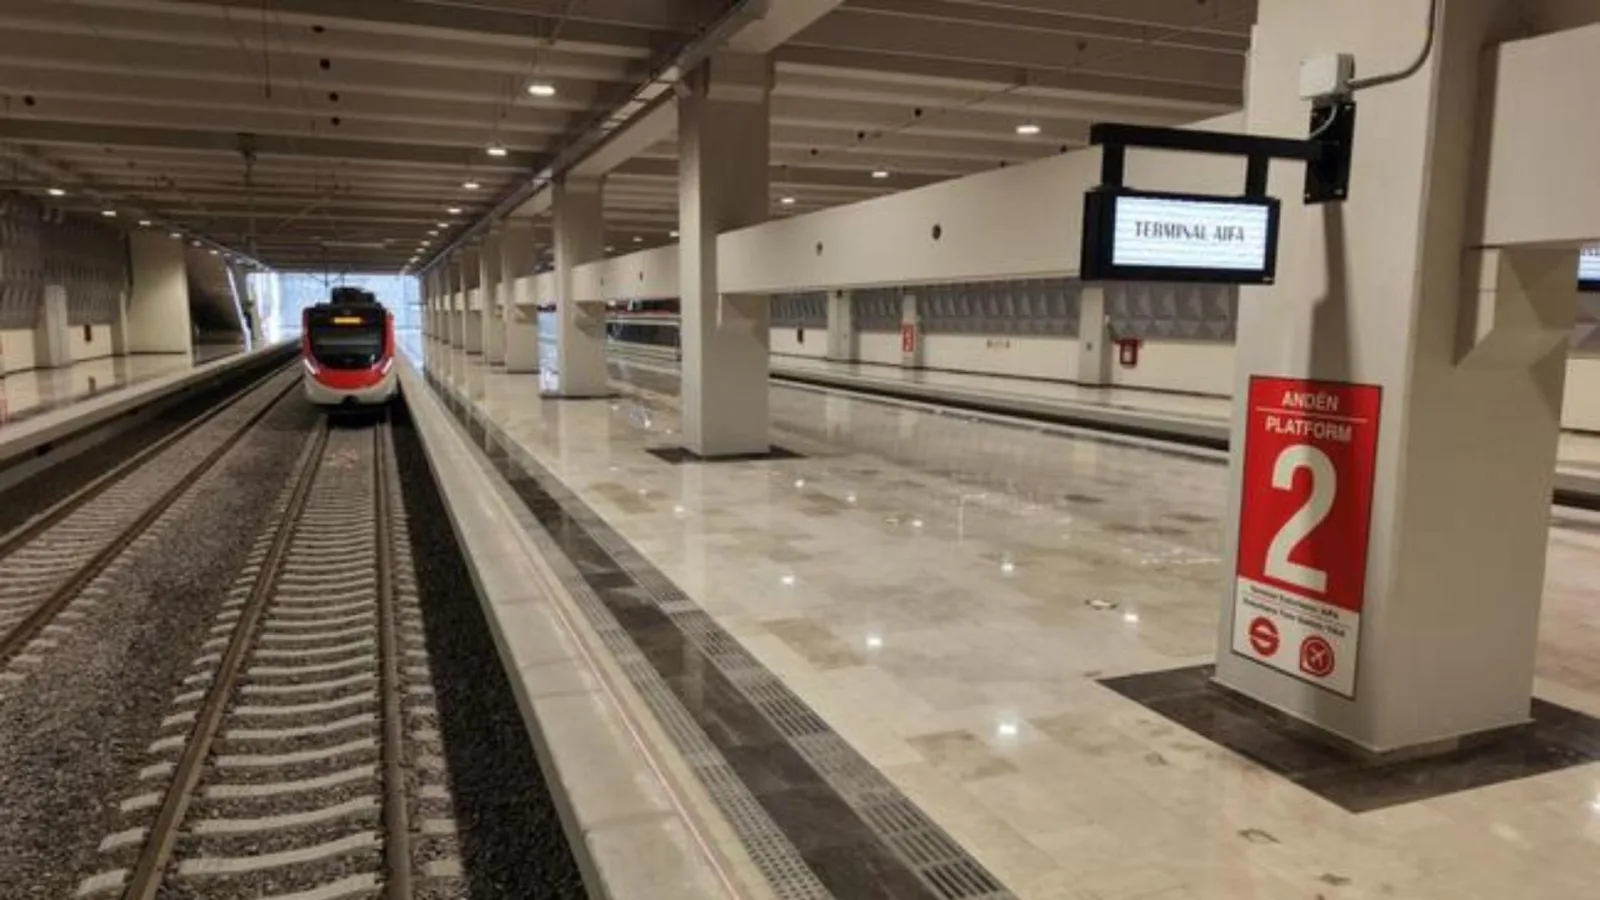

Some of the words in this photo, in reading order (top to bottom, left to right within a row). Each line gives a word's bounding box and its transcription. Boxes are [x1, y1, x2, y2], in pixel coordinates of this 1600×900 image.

[1135, 221, 1206, 240] TERMINAL
[1282, 389, 1339, 411] ANDÉN
[1265, 415, 1352, 442] PLATFORM
[1264, 444, 1337, 593] 2
